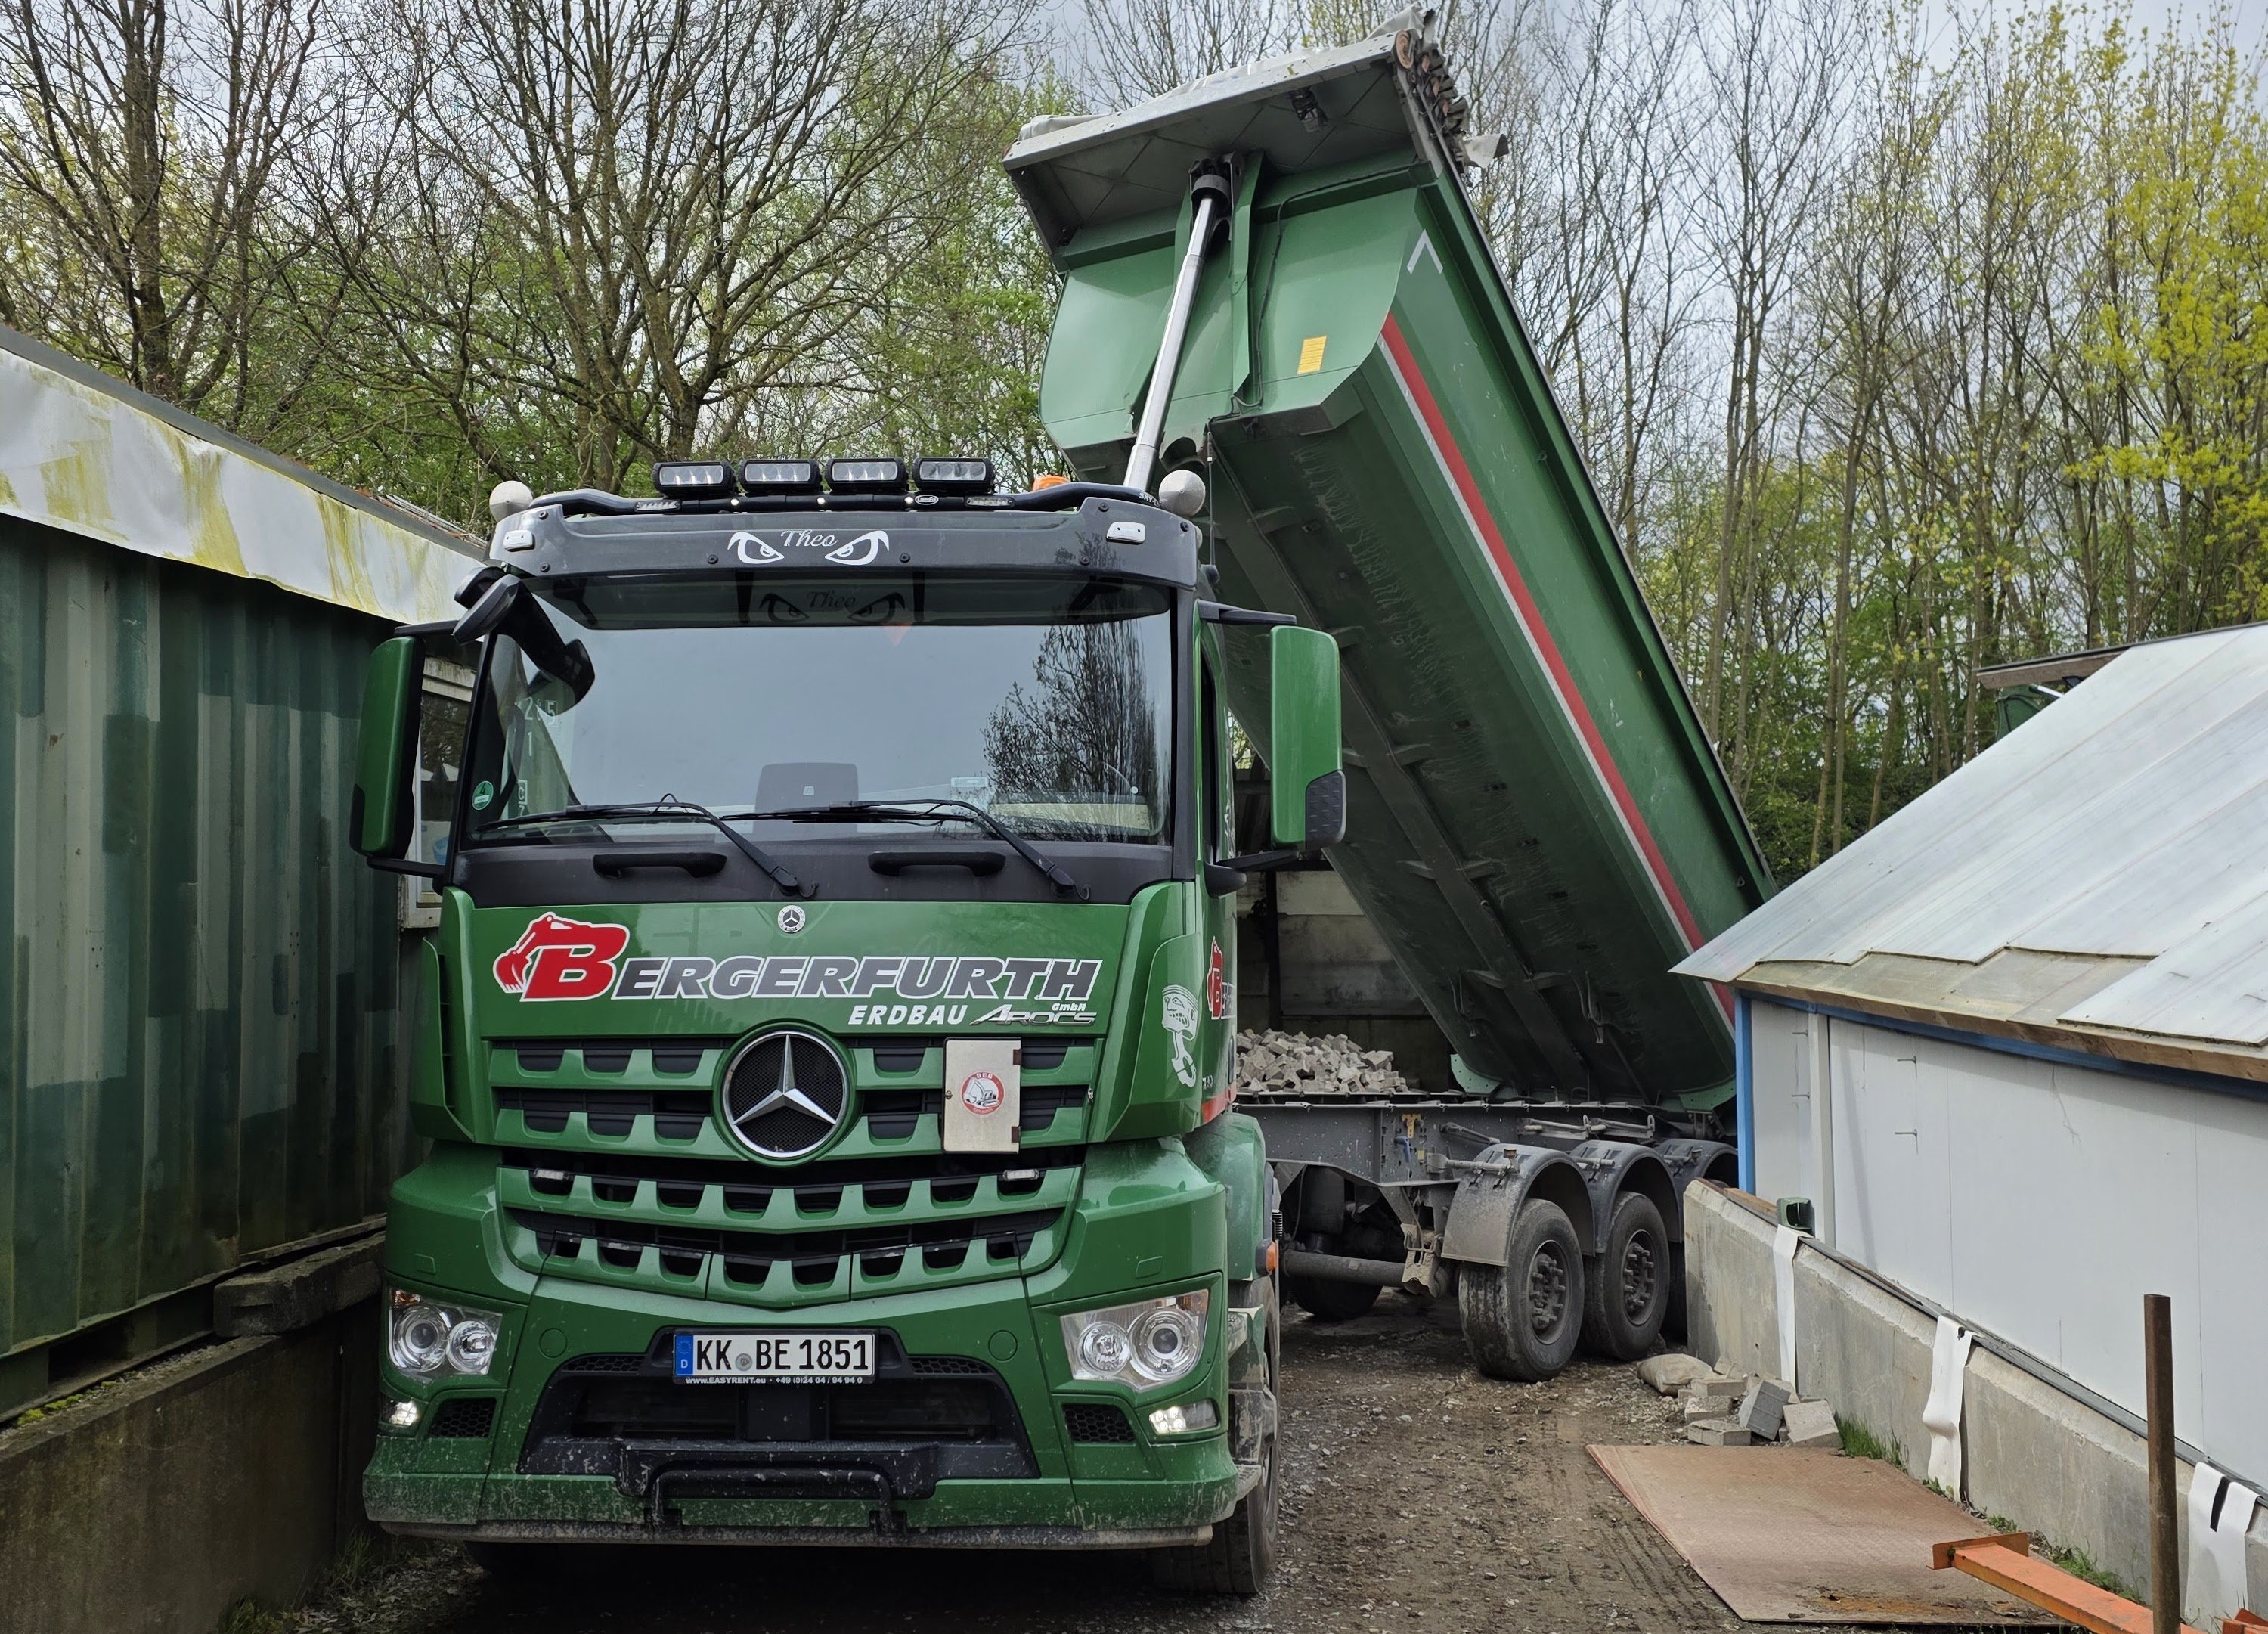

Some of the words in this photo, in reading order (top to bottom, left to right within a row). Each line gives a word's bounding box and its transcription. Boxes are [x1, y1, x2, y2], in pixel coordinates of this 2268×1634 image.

[780, 529, 838, 547] Theo
[520, 921, 1102, 1002] BERGERFURTH
[848, 1005, 968, 1025] ERDBAU
[969, 1004, 1097, 1025] AROCS
[1052, 1003, 1086, 1012] GmbH
[680, 1360, 688, 1369] D
[696, 1339, 732, 1370] KK
[756, 1339, 790, 1370] BE
[799, 1339, 868, 1370] 1851
